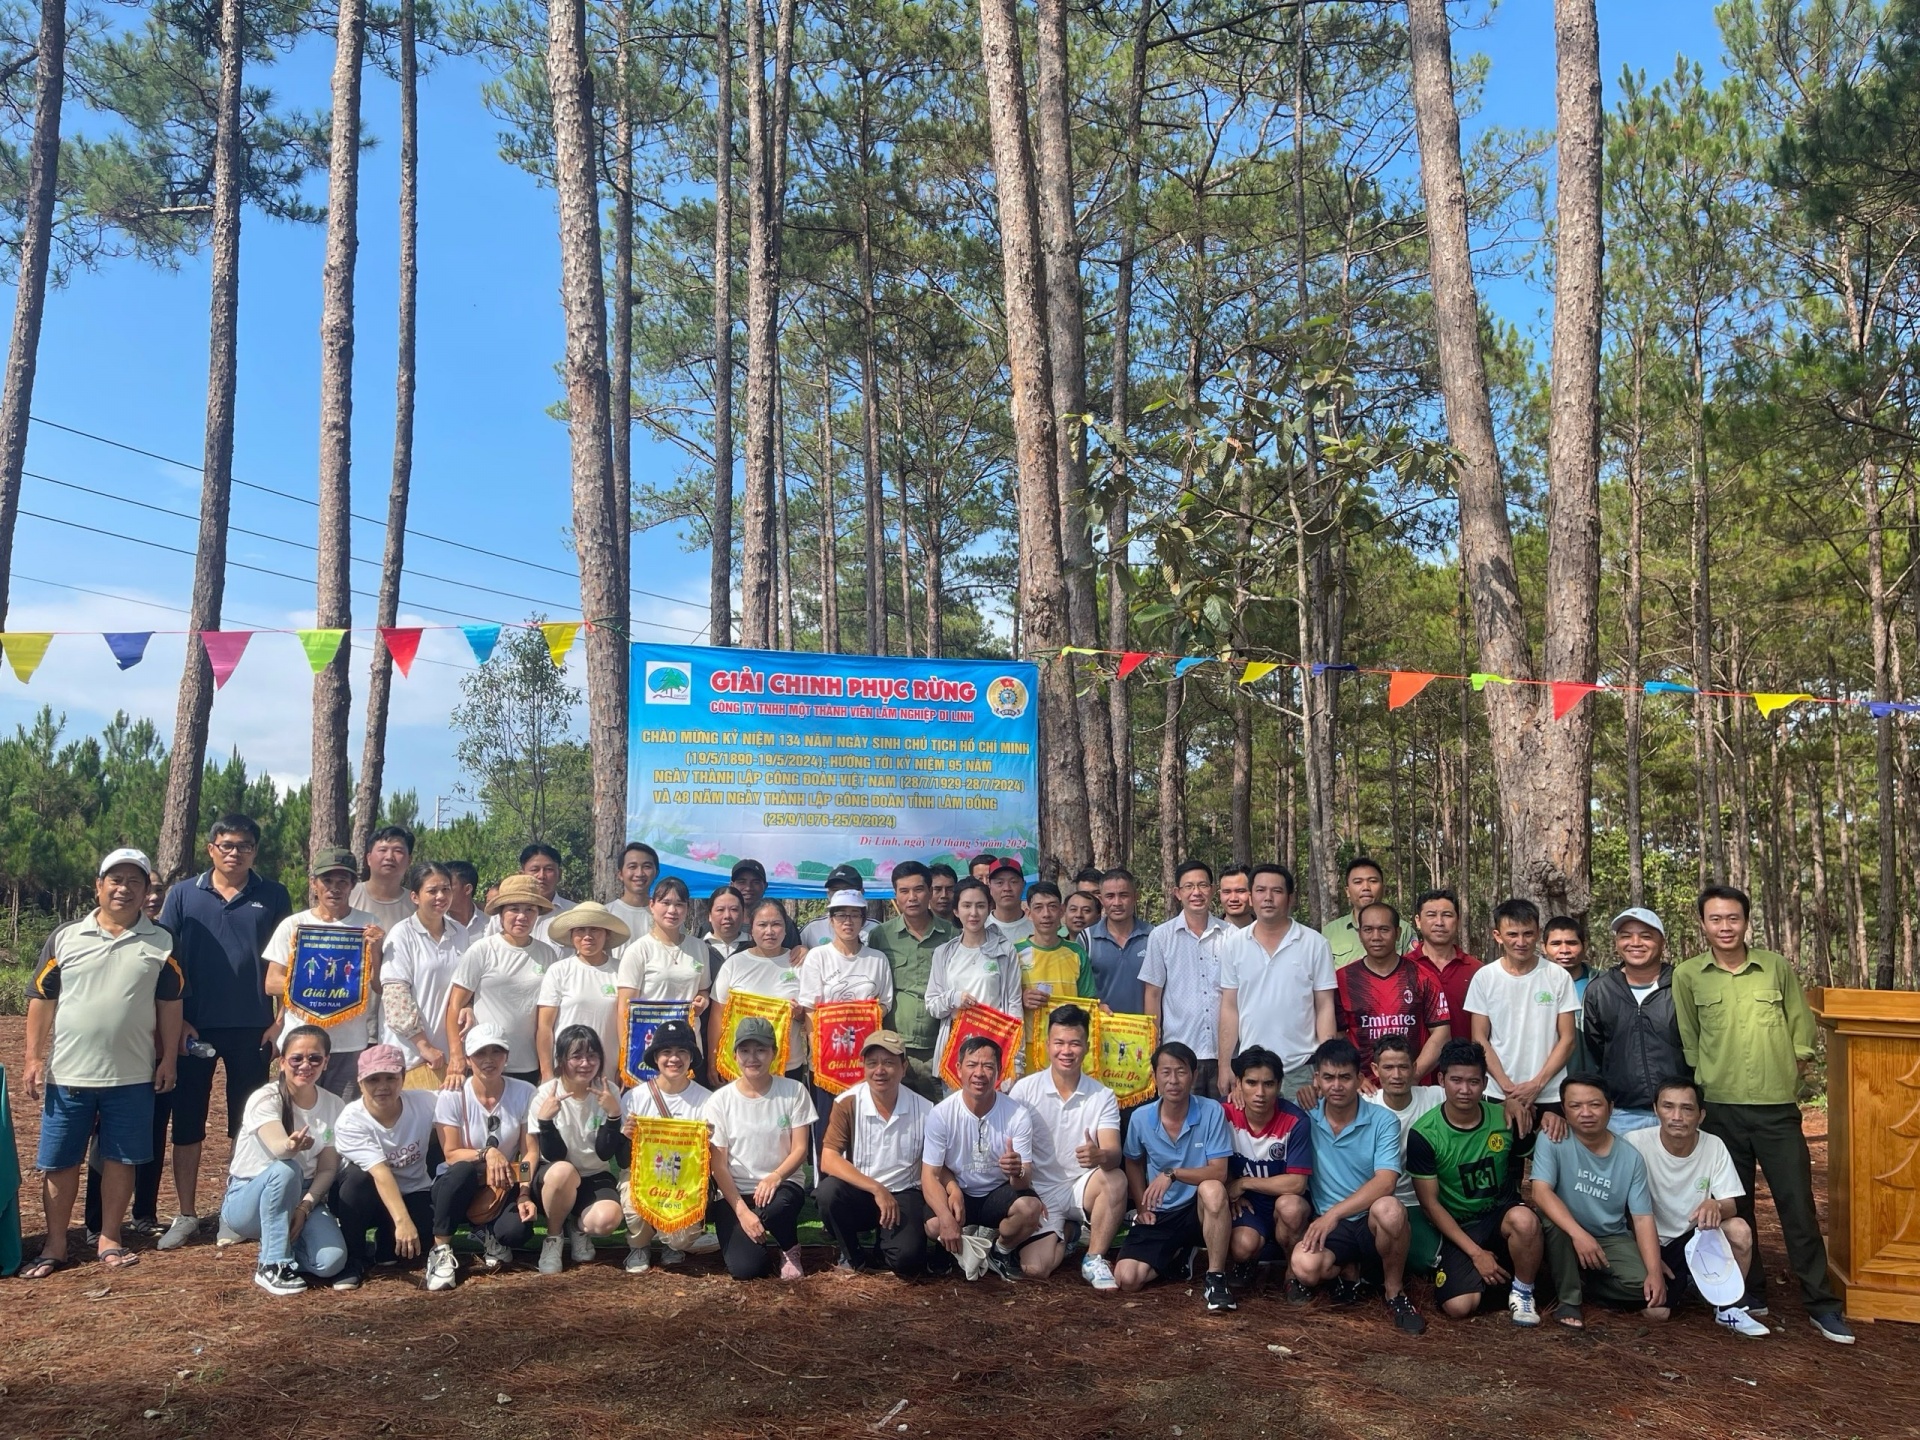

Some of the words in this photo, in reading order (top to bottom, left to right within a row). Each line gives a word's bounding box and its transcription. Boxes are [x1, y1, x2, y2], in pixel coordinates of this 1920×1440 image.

[711, 667, 763, 693] GIẢI
[769, 674, 842, 696] CHINH
[848, 678, 909, 703] PHỤC
[913, 676, 976, 702] RỪNG
[710, 699, 740, 713] CÔNG
[742, 703, 755, 713] TY
[758, 703, 785, 715] TNHH
[789, 702, 810, 718] MỘT
[813, 704, 847, 717] THÀNH
[850, 704, 873, 718] VIÊN
[876, 705, 897, 719] LÂM
[900, 707, 936, 724] NGHIỆP
[939, 710, 949, 721] DI
[951, 711, 974, 722] LINH
[642, 730, 676, 743] CHÀO
[681, 730, 718, 744] MỪNG
[722, 729, 739, 744] KỶ
[742, 732, 774, 748] NIỆM
[779, 735, 801, 745] 134
[804, 733, 832, 747] NĂM
[836, 735, 868, 749] NGÀY
[872, 738, 900, 750] SINH
[904, 735, 928, 751] CHỦ
[931, 739, 956, 754] TỊCH
[978, 740, 997, 753] CHÍ
[1000, 743, 1030, 755] MINH
[830, 755, 871, 769] HƯỚNG
[874, 755, 893, 769] TỚI
[896, 754, 911, 770] KỶ
[915, 758, 945, 774] NIỆM
[948, 761, 962, 772] 95
[965, 759, 992, 773] NĂM
[654, 769, 689, 784] NGÀY
[692, 769, 735, 784] THÀNH
[738, 768, 762, 787] LẬP
[765, 770, 799, 785] CÔNG
[802, 771, 836, 786] ĐOÀN
[840, 772, 864, 789] VIỆT
[868, 776, 896, 788] NAM
[900, 777, 1025, 793] (28/7/1929-28/7/2024)
[653, 788, 671, 804] VÀ
[673, 791, 690, 804] 48
[693, 790, 724, 804] NĂM
[727, 791, 760, 805] NGÀY
[764, 791, 805, 806] THÀNH
[808, 791, 832, 809] LẬP
[835, 793, 868, 807] CÔNG
[871, 792, 904, 808] ĐOÀN
[908, 791, 935, 808] TỈNH
[937, 794, 963, 809] LÂM
[763, 813, 896, 829] (25/9/1976-25/9/2024)
[860, 836, 872, 846] Di
[874, 836, 901, 847] Linh,
[904, 837, 926, 848] ngày
[931, 838, 942, 846] 19
[944, 837, 971, 849] tháng
[1006, 839, 1027, 849] 2024
[302, 987, 326, 998] Giải
[1360, 1013, 1417, 1028] Emirates
[1369, 1028, 1381, 1040] FLY
[1463, 1166, 1495, 1191] 1&1
[648, 1186, 673, 1198] Giải
